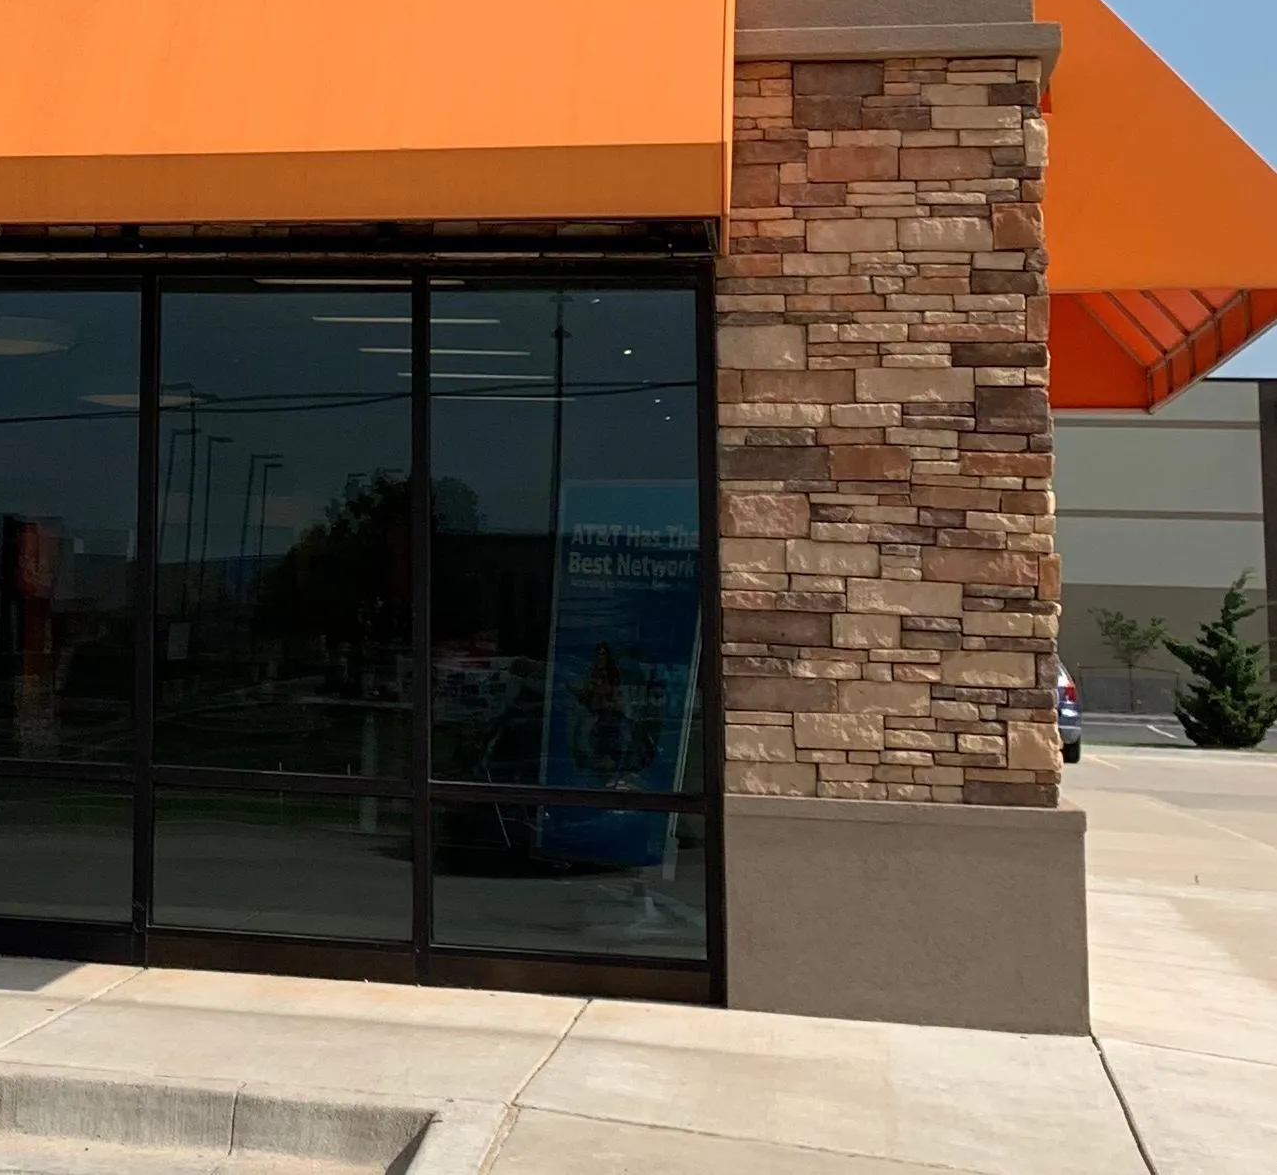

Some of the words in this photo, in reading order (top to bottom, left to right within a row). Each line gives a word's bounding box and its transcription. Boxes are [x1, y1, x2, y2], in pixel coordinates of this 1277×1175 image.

[571, 523, 622, 547] AT&T
[625, 524, 660, 548] Has
[568, 551, 612, 574] Best
[616, 552, 696, 578] Network
